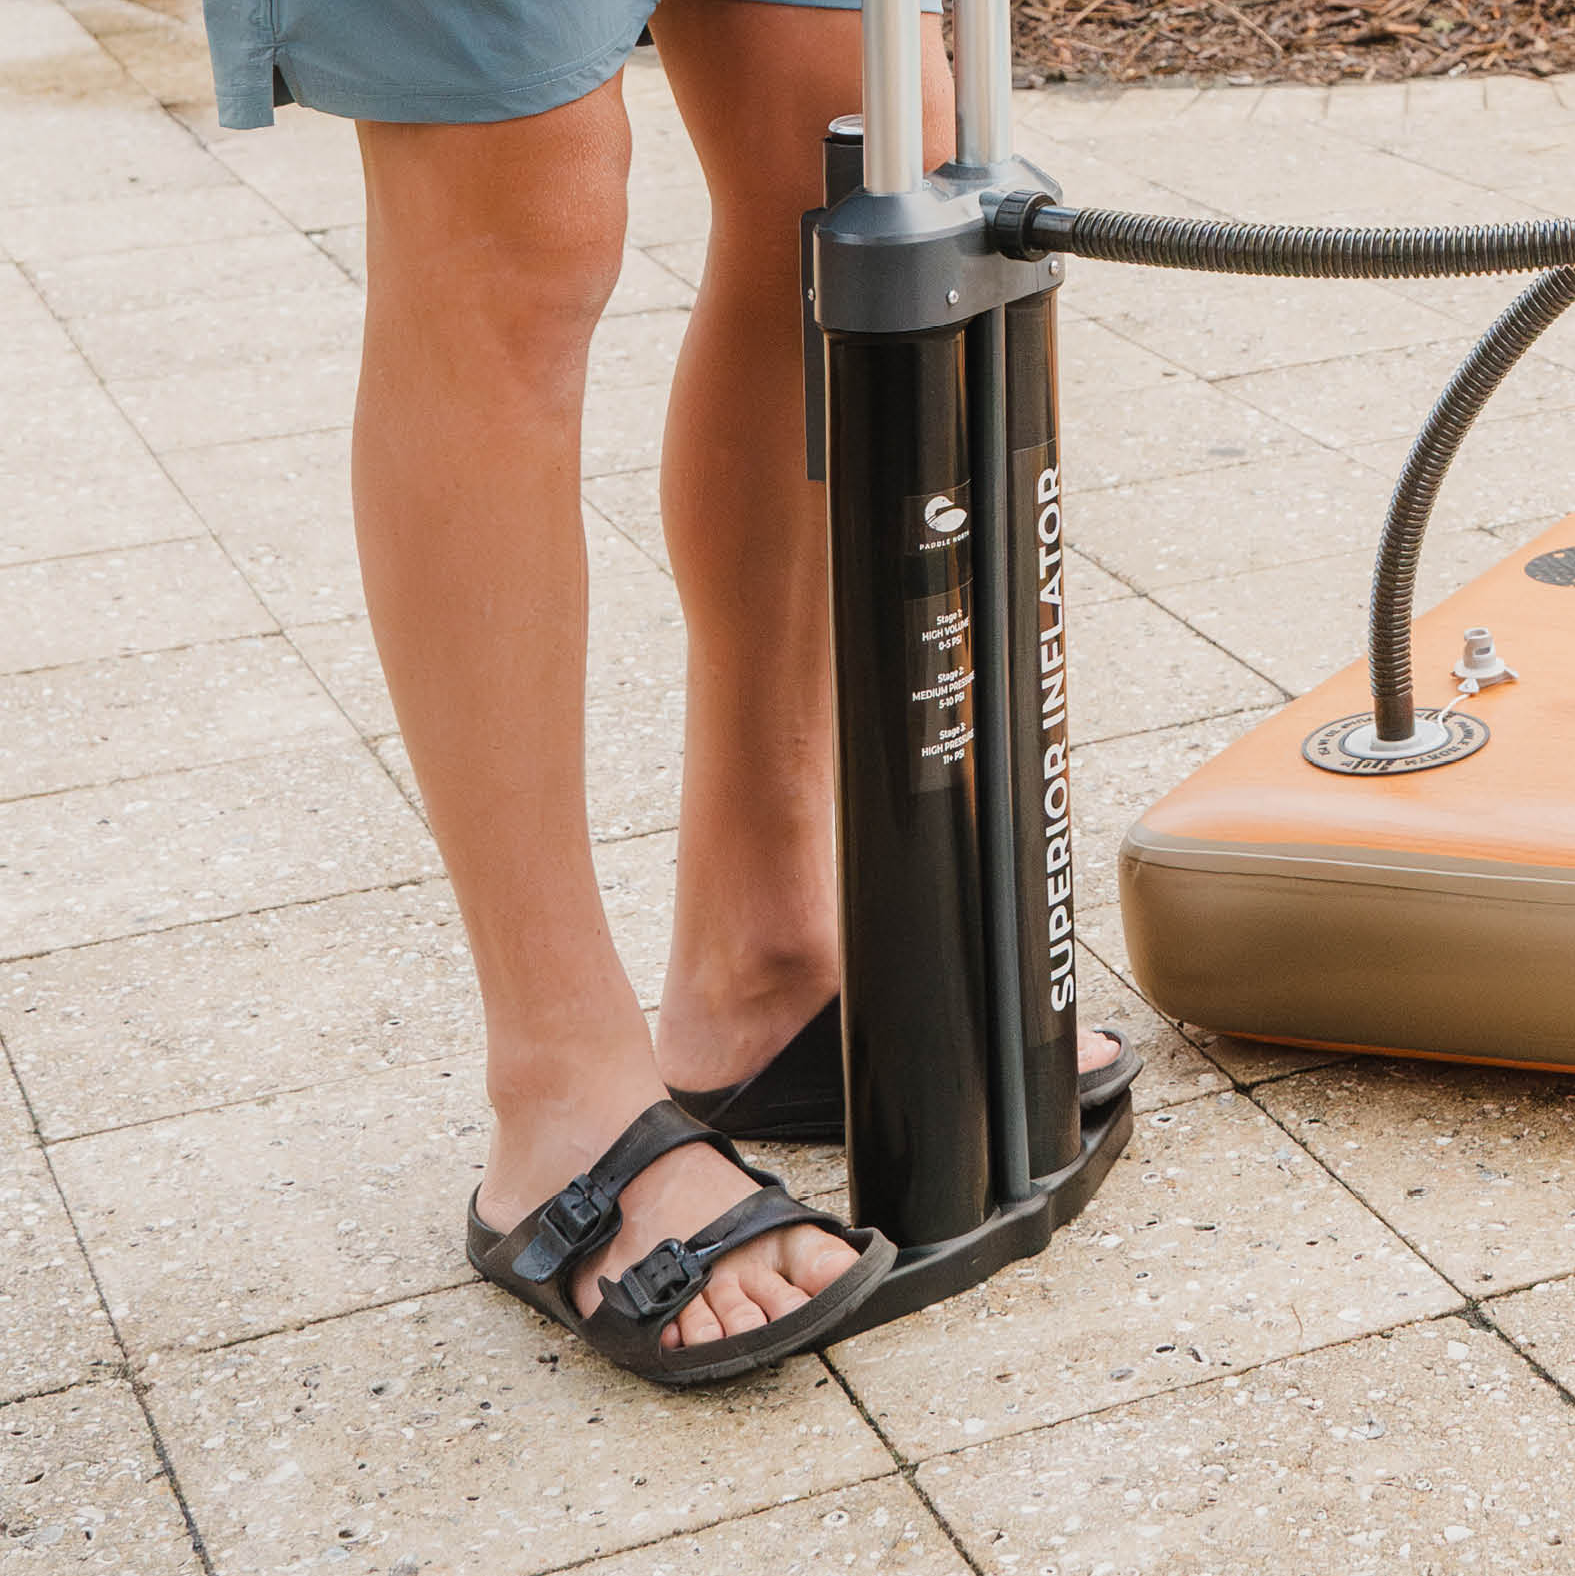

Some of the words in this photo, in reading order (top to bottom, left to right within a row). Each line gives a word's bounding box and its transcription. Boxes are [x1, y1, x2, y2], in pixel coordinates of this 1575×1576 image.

[919, 538, 951, 551] PADDLE
[1037, 462, 1067, 730] INFLATOR
[936, 611, 958, 627] Stage
[921, 627, 944, 642] HIGH
[938, 638, 951, 651] 0-5
[937, 669, 958, 684] Stage
[912, 684, 948, 702] MEDIUM
[938, 695, 954, 709] 5-10
[954, 691, 965, 704] PSI
[939, 726, 960, 740] Stage
[921, 743, 943, 757] HIGH
[942, 754, 953, 765] 11+
[954, 748, 965, 761] PSI
[1044, 735, 1075, 1012] SUPERIOR
